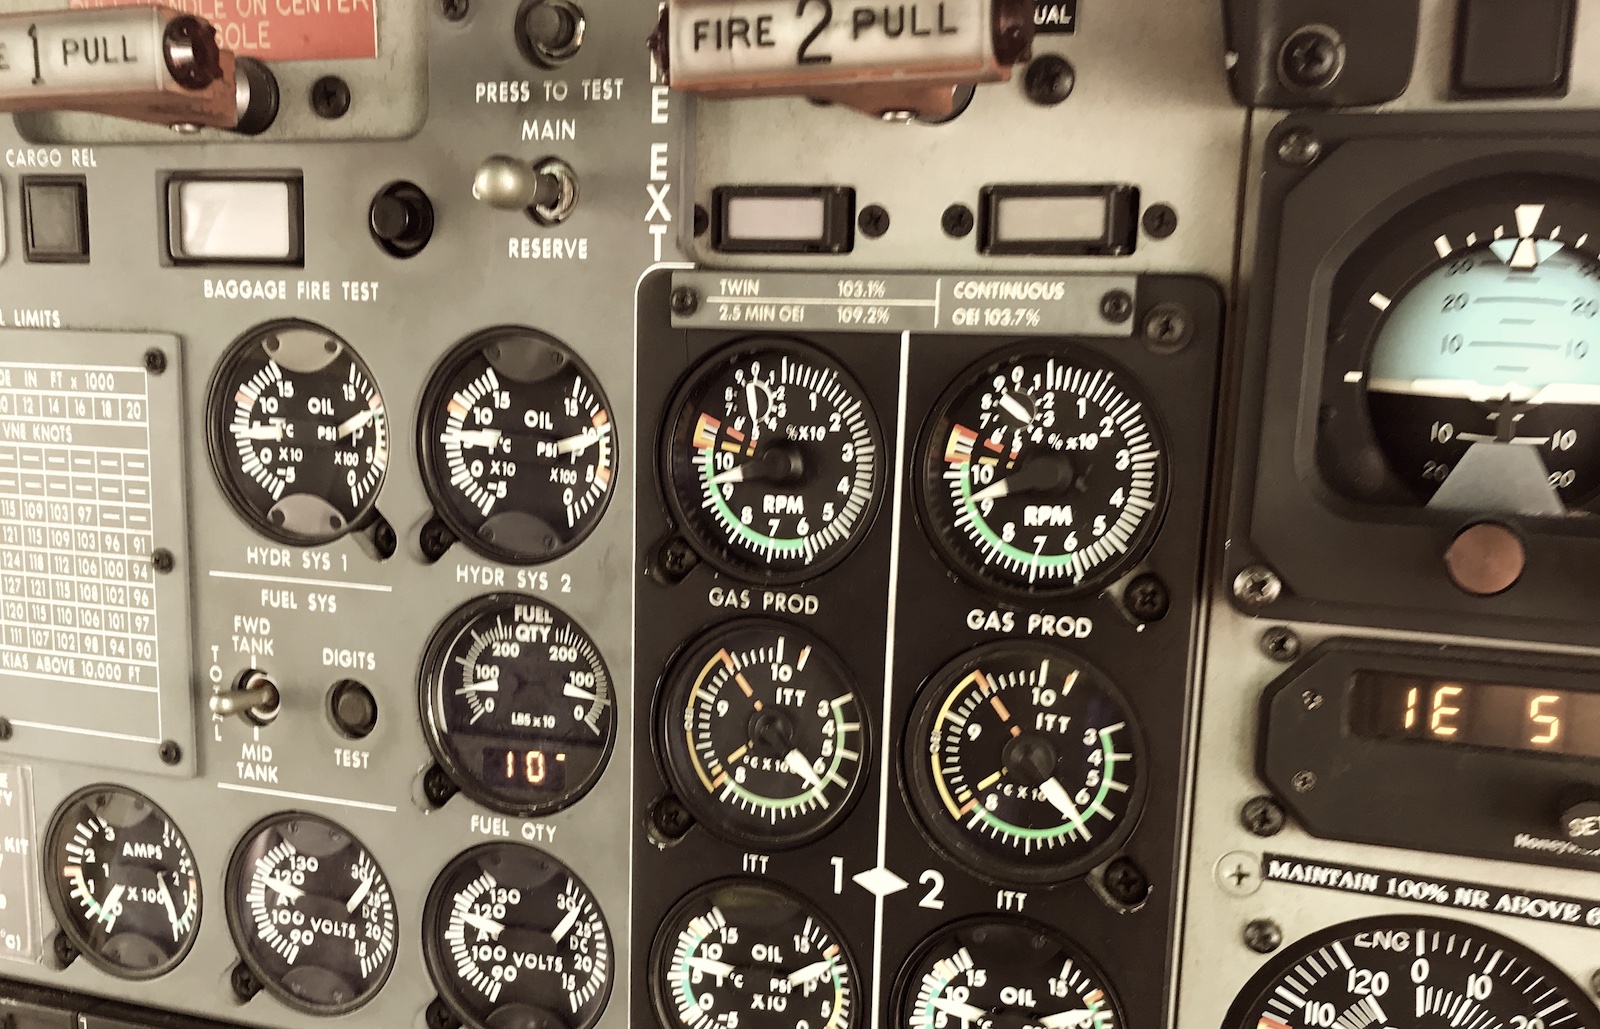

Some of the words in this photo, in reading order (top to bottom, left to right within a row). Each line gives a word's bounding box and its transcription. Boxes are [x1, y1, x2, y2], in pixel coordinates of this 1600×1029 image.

[693, 15, 776, 52] FIRE
[796, 0, 833, 65] 2
[851, 3, 959, 40] PULL
[28, 23, 45, 85] 1
[62, 35, 138, 67] PULL
[476, 81, 530, 103] PRESS
[543, 80, 568, 101] TO
[582, 78, 624, 100] TEST
[522, 119, 576, 141] MAIN
[6, 148, 62, 168] CARGO
[72, 148, 97, 168] REL
[508, 238, 588, 260] RESERVE
[204, 279, 286, 299] BAGGAGE
[297, 280, 330, 300] FIRE
[342, 281, 378, 301] TEST
[720, 279, 759, 296] TWIN
[837, 280, 885, 298] 103.1%
[954, 281, 1065, 300] CONTINUOUS
[1441, 292, 1470, 314] 20
[14, 309, 61, 328] LIMITS
[719, 304, 741, 321] 2.5
[745, 305, 775, 322] MIN
[779, 306, 805, 322] OEI
[837, 306, 890, 324] 109.2%
[952, 308, 980, 325] OEI
[984, 308, 1040, 327] 103.7%
[24, 372, 37, 388] IN
[50, 372, 63, 389] FT
[85, 373, 114, 391] 1000
[277, 380, 294, 398] 15
[343, 384, 356, 401] 15
[493, 390, 510, 409] 15
[809, 392, 818, 411] 1
[23, 397, 34, 413] 12
[49, 398, 59, 414] 14
[74, 399, 85, 416] 16
[101, 400, 112, 418] 18
[127, 401, 141, 419] 20
[259, 397, 278, 414] 10
[308, 397, 334, 416] OIL
[564, 397, 578, 417] 15
[1076, 397, 1087, 419] 1
[473, 407, 493, 425] 10
[524, 409, 553, 430] OIL
[829, 412, 842, 432] 2
[3, 423, 26, 440] VNE
[33, 424, 72, 443] KNOTS
[317, 422, 336, 441] PSI
[1100, 416, 1114, 438] 2
[1430, 421, 1454, 444] 10
[537, 441, 558, 458] PSI
[1552, 429, 1577, 451] 10
[260, 448, 273, 464] 0
[715, 452, 734, 471] 10
[842, 443, 854, 463] 3
[1115, 449, 1130, 471] 3
[471, 460, 484, 477] 0
[971, 463, 994, 485] 10
[763, 494, 804, 515] RPM
[741, 506, 753, 525] 8
[1024, 505, 1073, 526] RPM
[3, 526, 18, 543] 121
[28, 527, 42, 546] 115
[51, 530, 70, 548] 109
[77, 532, 95, 550] 103
[1002, 522, 1015, 543] 8
[105, 535, 120, 552] 96
[133, 537, 145, 554] 91
[247, 546, 291, 567] HYDR
[302, 550, 331, 570] SYS
[342, 554, 347, 571] 1
[456, 564, 505, 586] HYDR
[517, 570, 549, 590] SYS
[561, 574, 571, 592] 2
[261, 588, 297, 609] FUEL
[309, 593, 337, 613] SYS
[709, 587, 750, 609] GAS
[763, 591, 819, 615] PROD
[514, 604, 553, 623] FUEL
[234, 615, 270, 635] FWD
[966, 608, 1015, 633] GAS
[1028, 613, 1093, 639] PROD
[515, 624, 551, 643] QTY
[232, 635, 274, 656] TANK
[492, 642, 520, 658] 200
[549, 646, 577, 662] 200
[2, 652, 28, 670] KIAS
[36, 656, 75, 675] ABOVE
[81, 660, 121, 681] 10,000
[129, 666, 140, 683] FT
[322, 647, 376, 670] DIGITS
[476, 665, 499, 679] 100
[570, 671, 595, 687] 100
[771, 663, 793, 682] 10
[776, 687, 806, 707] ITT
[1032, 687, 1057, 707] 10
[717, 700, 729, 718] 9
[817, 700, 829, 718] 3
[511, 712, 530, 727] LBS
[543, 714, 556, 729] 10
[1036, 713, 1071, 734] ITT
[967, 723, 982, 741] 9
[242, 743, 272, 763] MID
[334, 748, 369, 769] TEST
[237, 762, 278, 784] TANK
[471, 814, 510, 837] FUEL
[521, 821, 557, 843] QTY
[4, 836, 28, 855] KIT
[123, 842, 162, 860] AMPS
[290, 855, 319, 872] 130
[742, 853, 770, 874] ITT
[831, 856, 844, 895] 1
[918, 868, 945, 910] 2
[1267, 860, 1379, 892] MAINTAIN
[1387, 876, 1449, 904] 100%
[1453, 889, 1490, 909] NR
[1493, 894, 1581, 923] ABOVE
[490, 888, 521, 905] 130
[997, 889, 1028, 912] ITT
[272, 909, 305, 926] 100
[290, 928, 314, 946] 90
[310, 916, 356, 939] VOLTS
[365, 922, 381, 941] 20
[720, 927, 739, 945] 15
[354, 939, 367, 957] 15
[570, 934, 588, 954] DC
[1354, 931, 1410, 951] ENG
[471, 944, 507, 962] 100
[700, 943, 723, 961] 10
[751, 944, 783, 963] OIL
[513, 951, 563, 973] VOLTS
[574, 953, 592, 973] 20
[1410, 958, 1430, 984] 0
[492, 964, 517, 982] 90
[562, 972, 576, 991] 15
[966, 969, 987, 988] 15
[1348, 967, 1390, 996] 120
[770, 978, 791, 994] PSI
[1465, 974, 1493, 1000] 10
[699, 993, 714, 1011] 0
[1000, 986, 1036, 1008] OIL
[1303, 1000, 1336, 1027] 110
